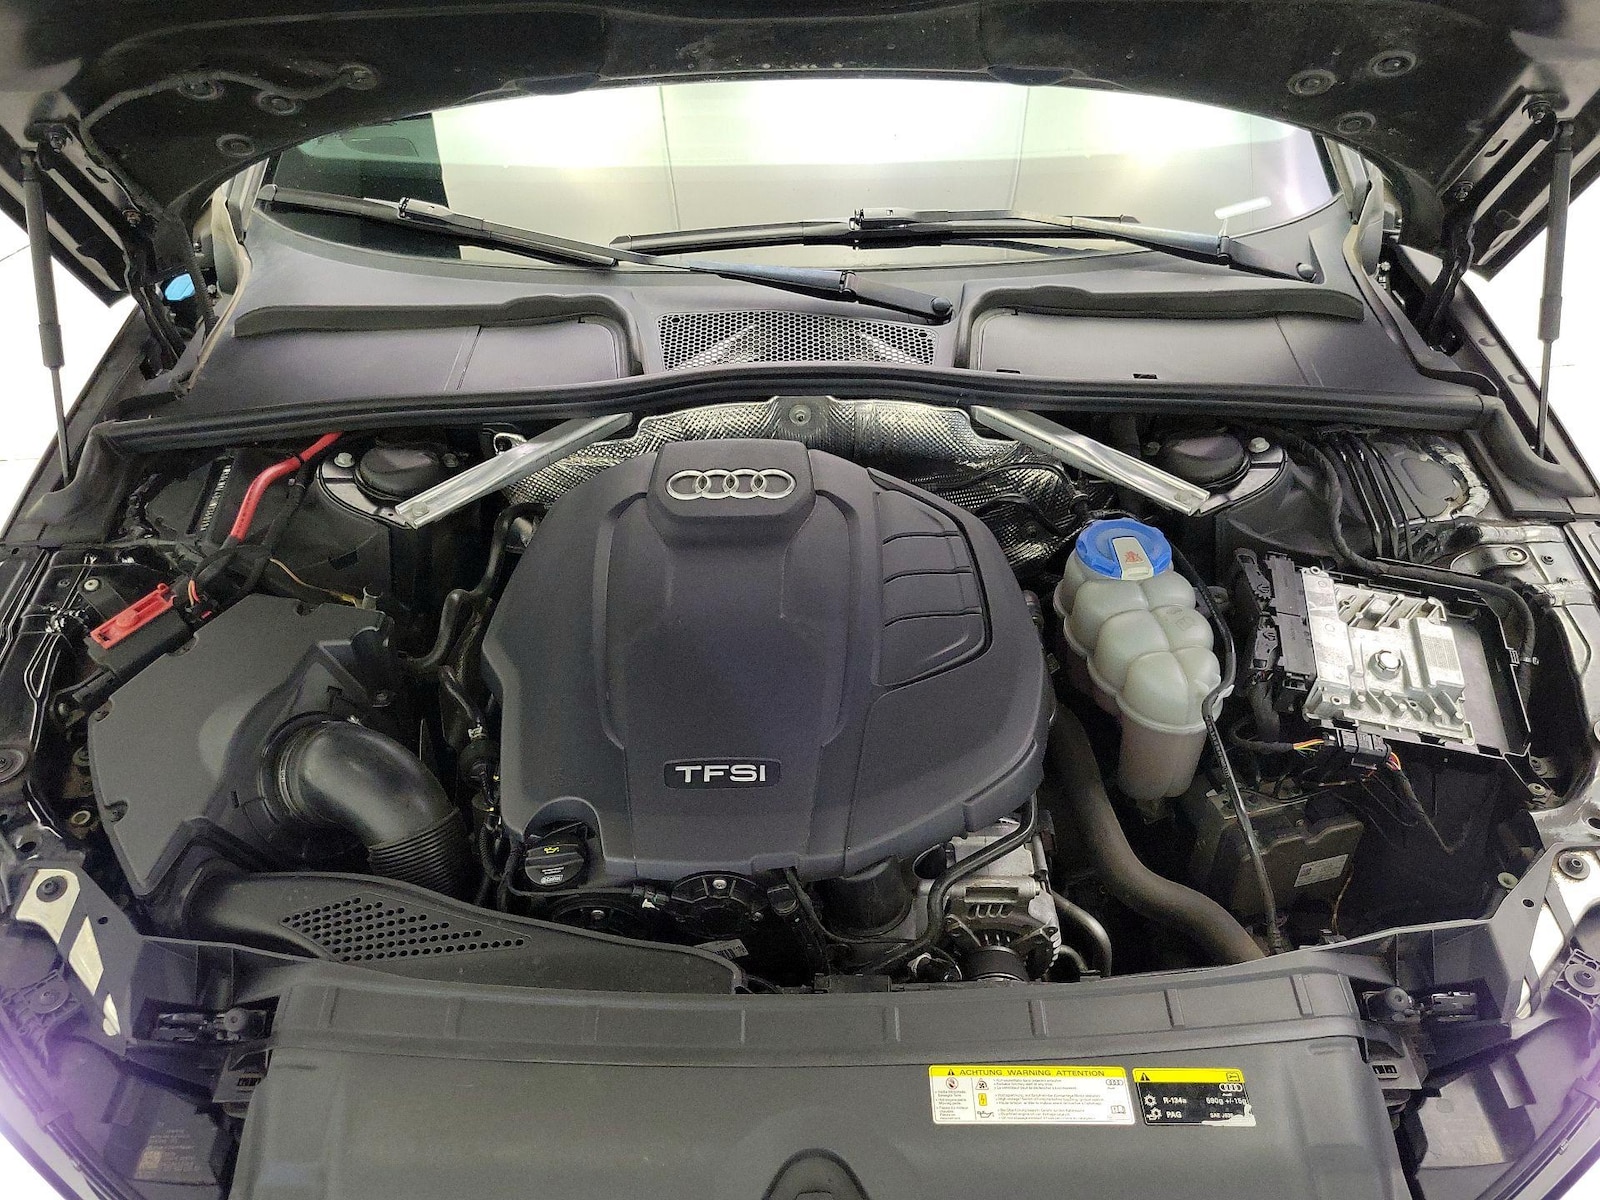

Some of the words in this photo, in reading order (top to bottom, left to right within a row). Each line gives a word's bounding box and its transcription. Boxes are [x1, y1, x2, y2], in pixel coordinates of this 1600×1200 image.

[675, 764, 766, 783] TFSI
[959, 1069, 1003, 1077] ACHTUNG
[1007, 1069, 1052, 1077] WARNING
[1166, 1111, 1183, 1119] PAG
